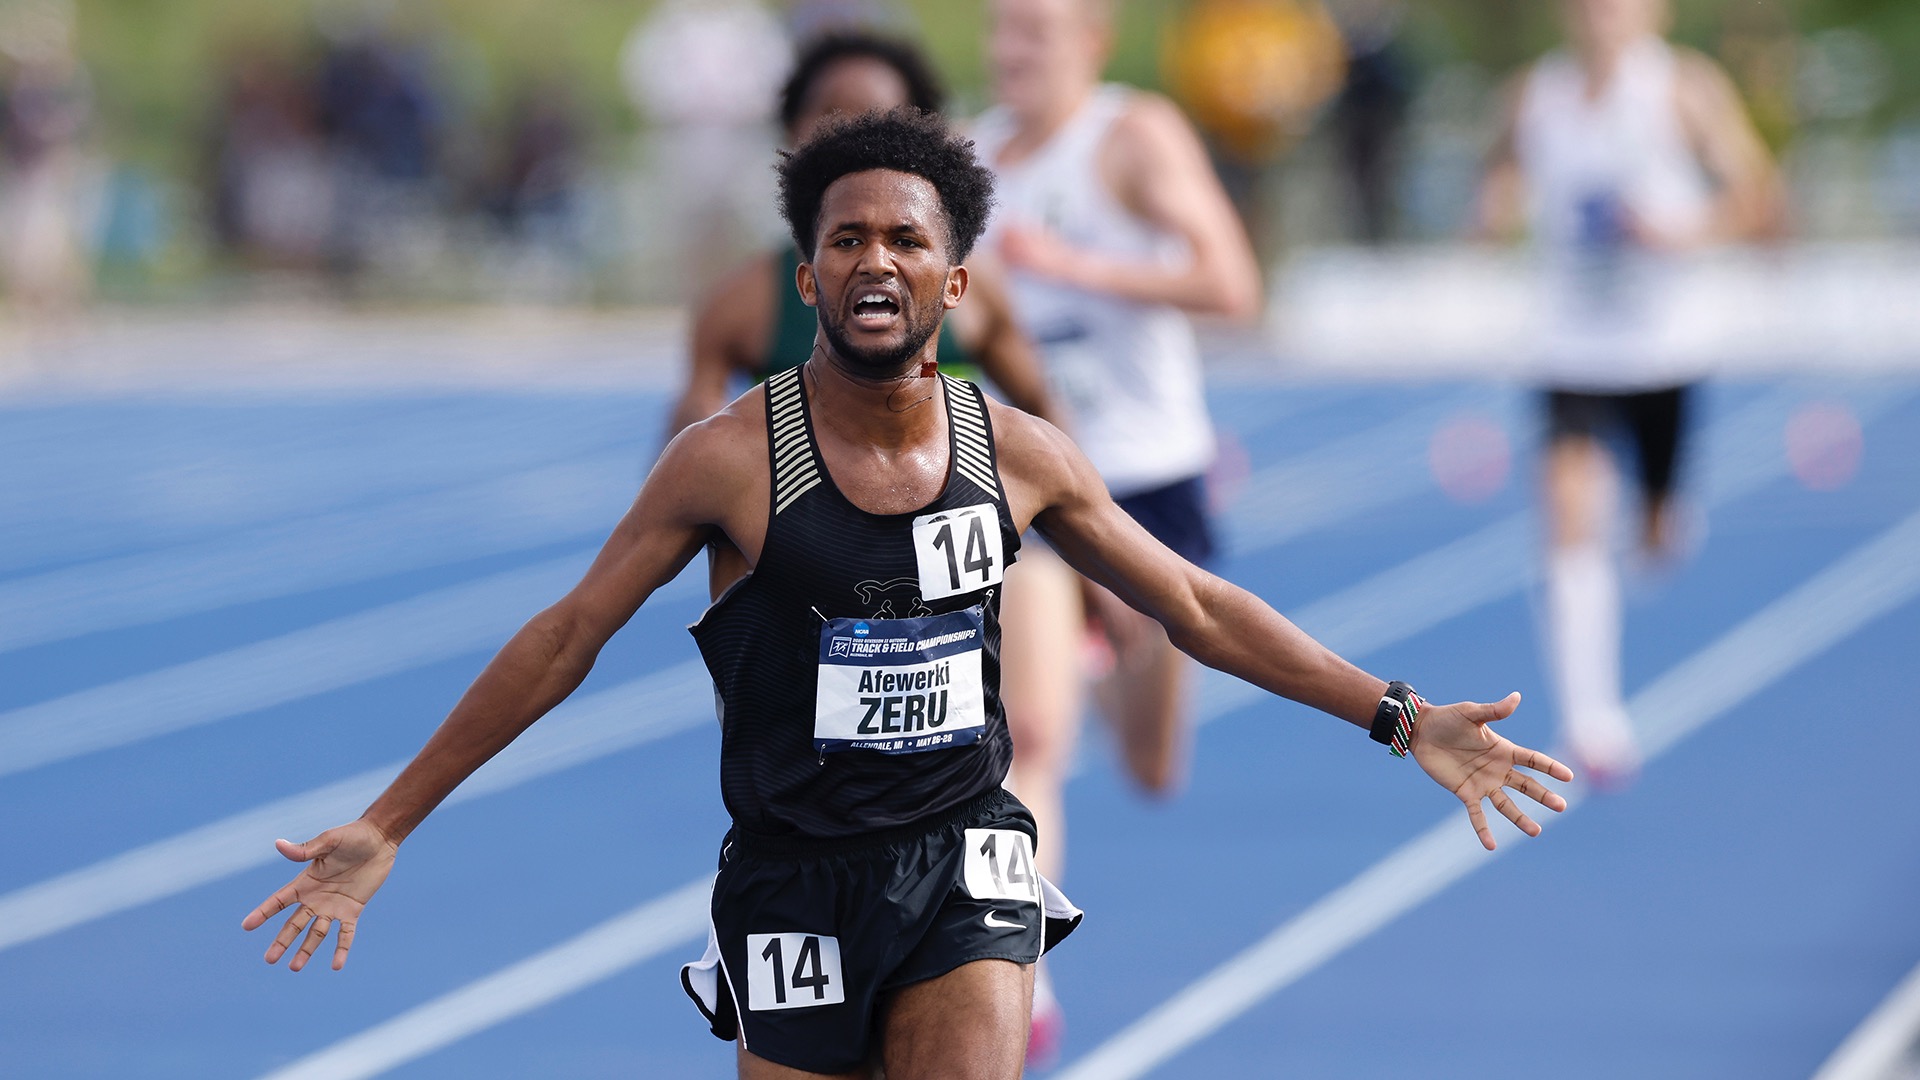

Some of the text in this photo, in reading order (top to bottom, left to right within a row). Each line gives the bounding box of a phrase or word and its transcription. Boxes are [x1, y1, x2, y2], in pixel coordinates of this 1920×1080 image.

[932, 515, 993, 591] 14
[851, 629, 977, 653] TRACK & FIELD CHAMPIONSHIPS
[857, 661, 950, 694] Afewerki
[856, 689, 948, 735] ZERU
[850, 741, 892, 751] ALLENDALE,
[893, 740, 904, 750] MI
[915, 736, 932, 748] MAY
[931, 733, 953, 745] 26-28
[980, 833, 1036, 897] 14
[761, 936, 830, 1005] 14
